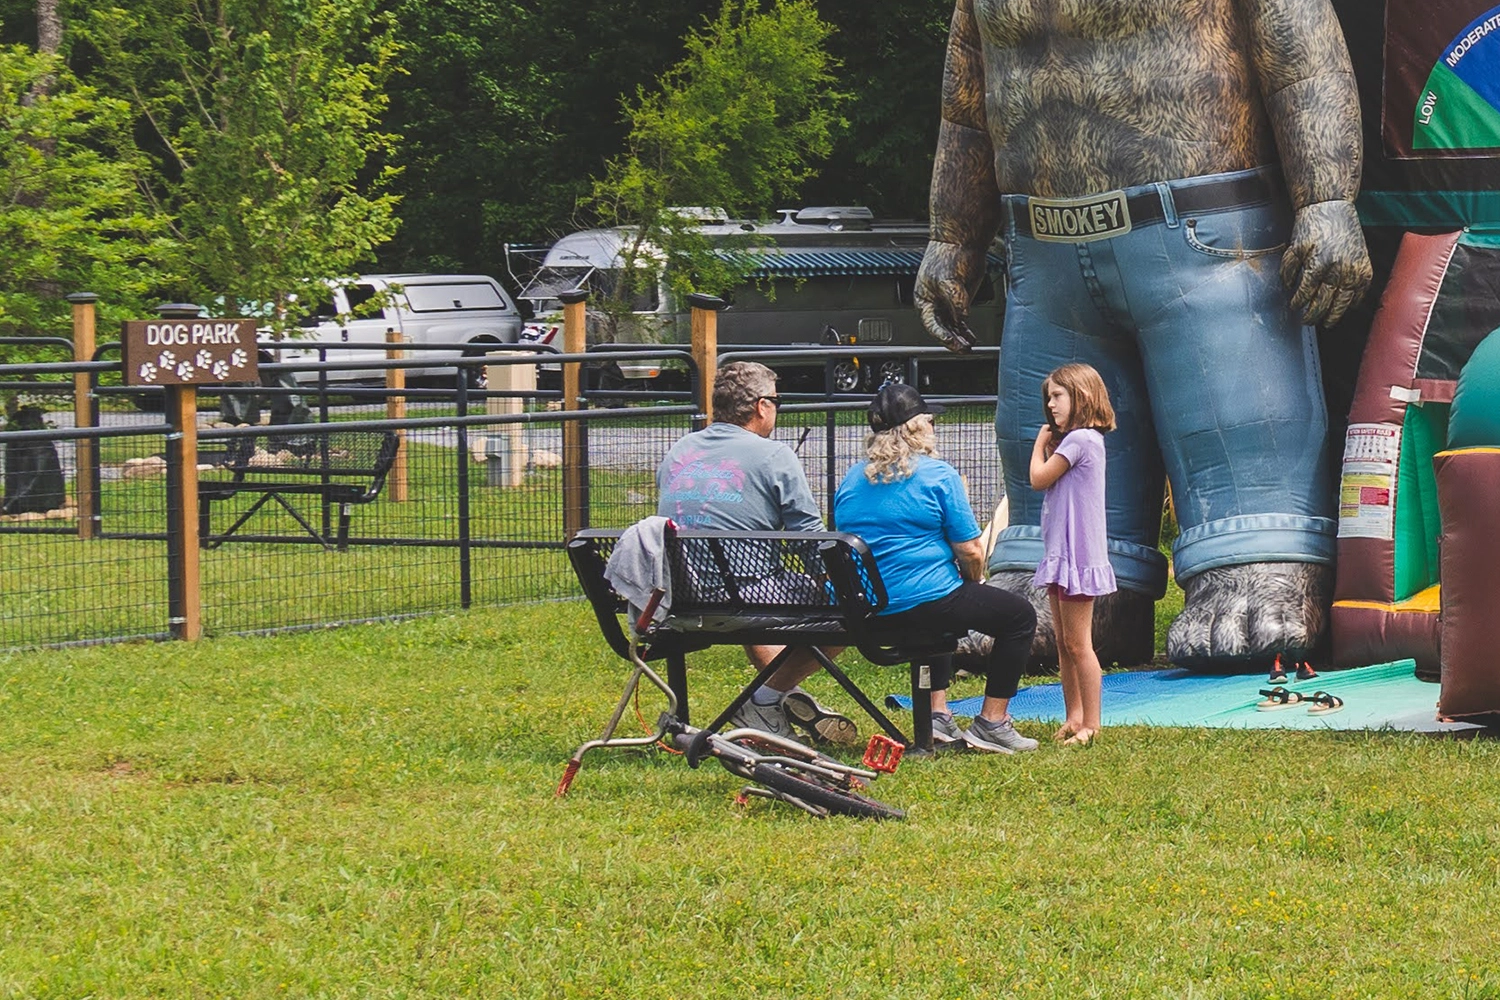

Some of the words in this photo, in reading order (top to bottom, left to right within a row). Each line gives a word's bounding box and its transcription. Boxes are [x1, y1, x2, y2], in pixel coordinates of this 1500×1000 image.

[1418, 90, 1438, 126] LOW
[1035, 200, 1119, 235] SMOKEY
[147, 324, 189, 345] DOG
[192, 323, 241, 344] PARK
